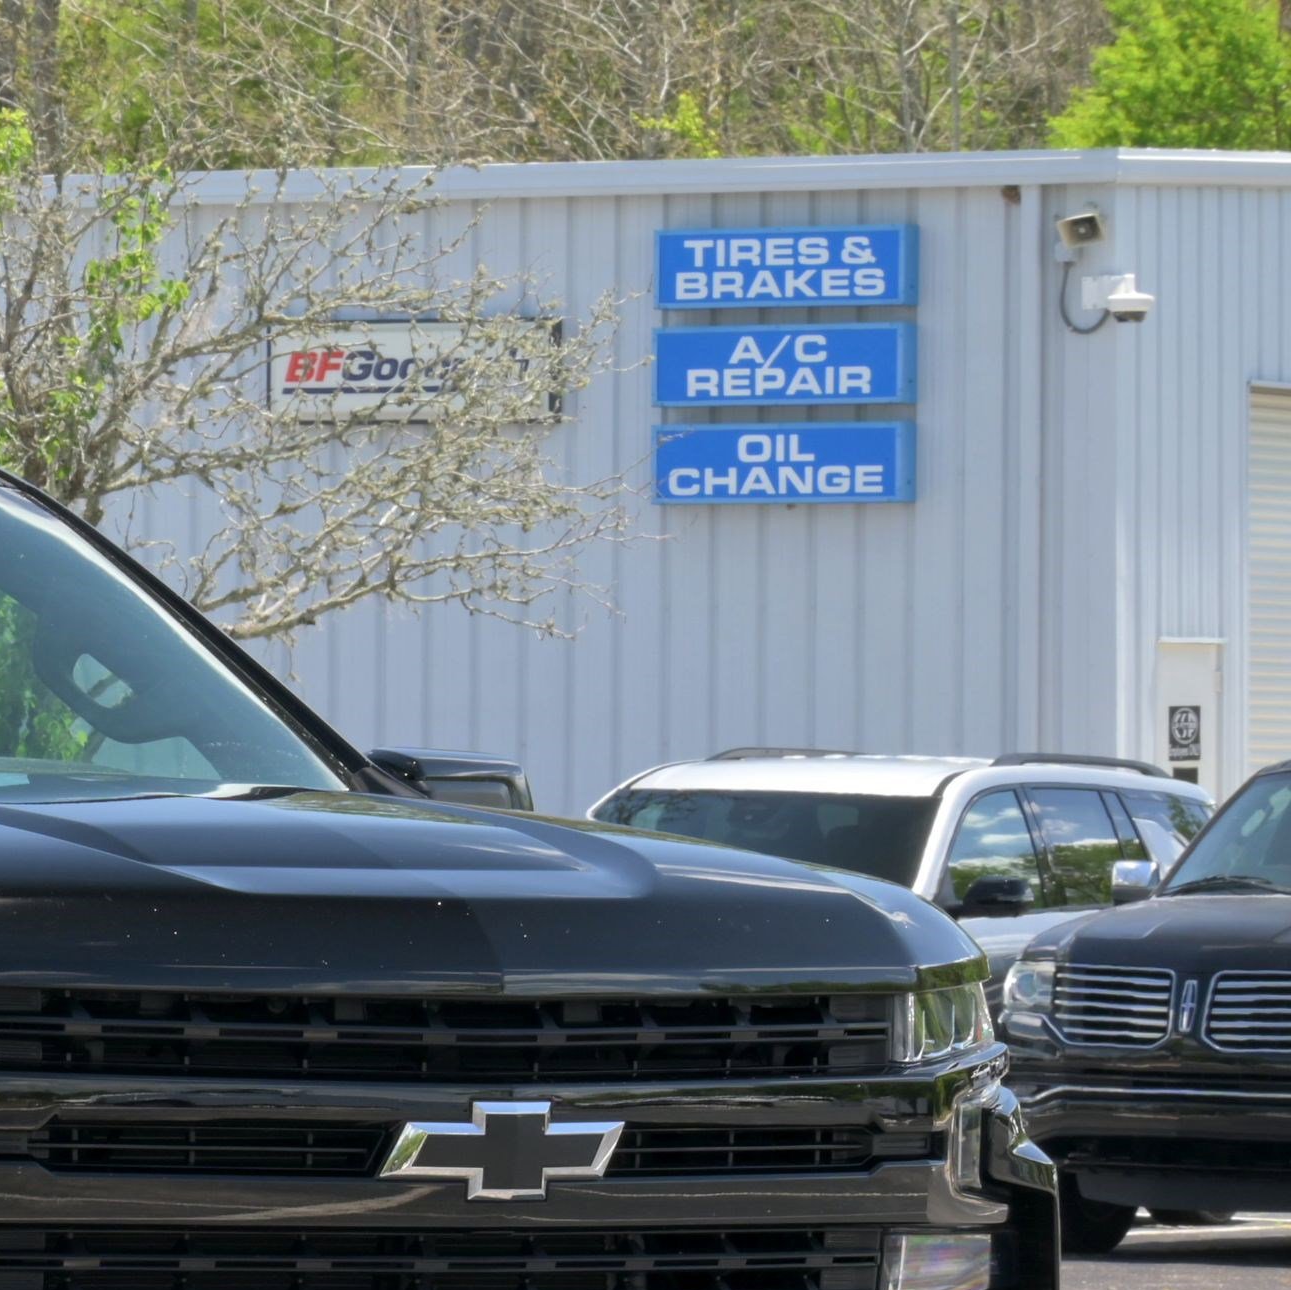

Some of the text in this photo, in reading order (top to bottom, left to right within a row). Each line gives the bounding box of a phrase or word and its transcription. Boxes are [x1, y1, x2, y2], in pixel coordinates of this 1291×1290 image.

[684, 236, 876, 268] TIRES &
[675, 268, 886, 300] BRAKES
[729, 334, 828, 369] A/C
[686, 366, 872, 397] REPAIR
[737, 434, 815, 463] OIL
[668, 465, 883, 496] CHANGE
